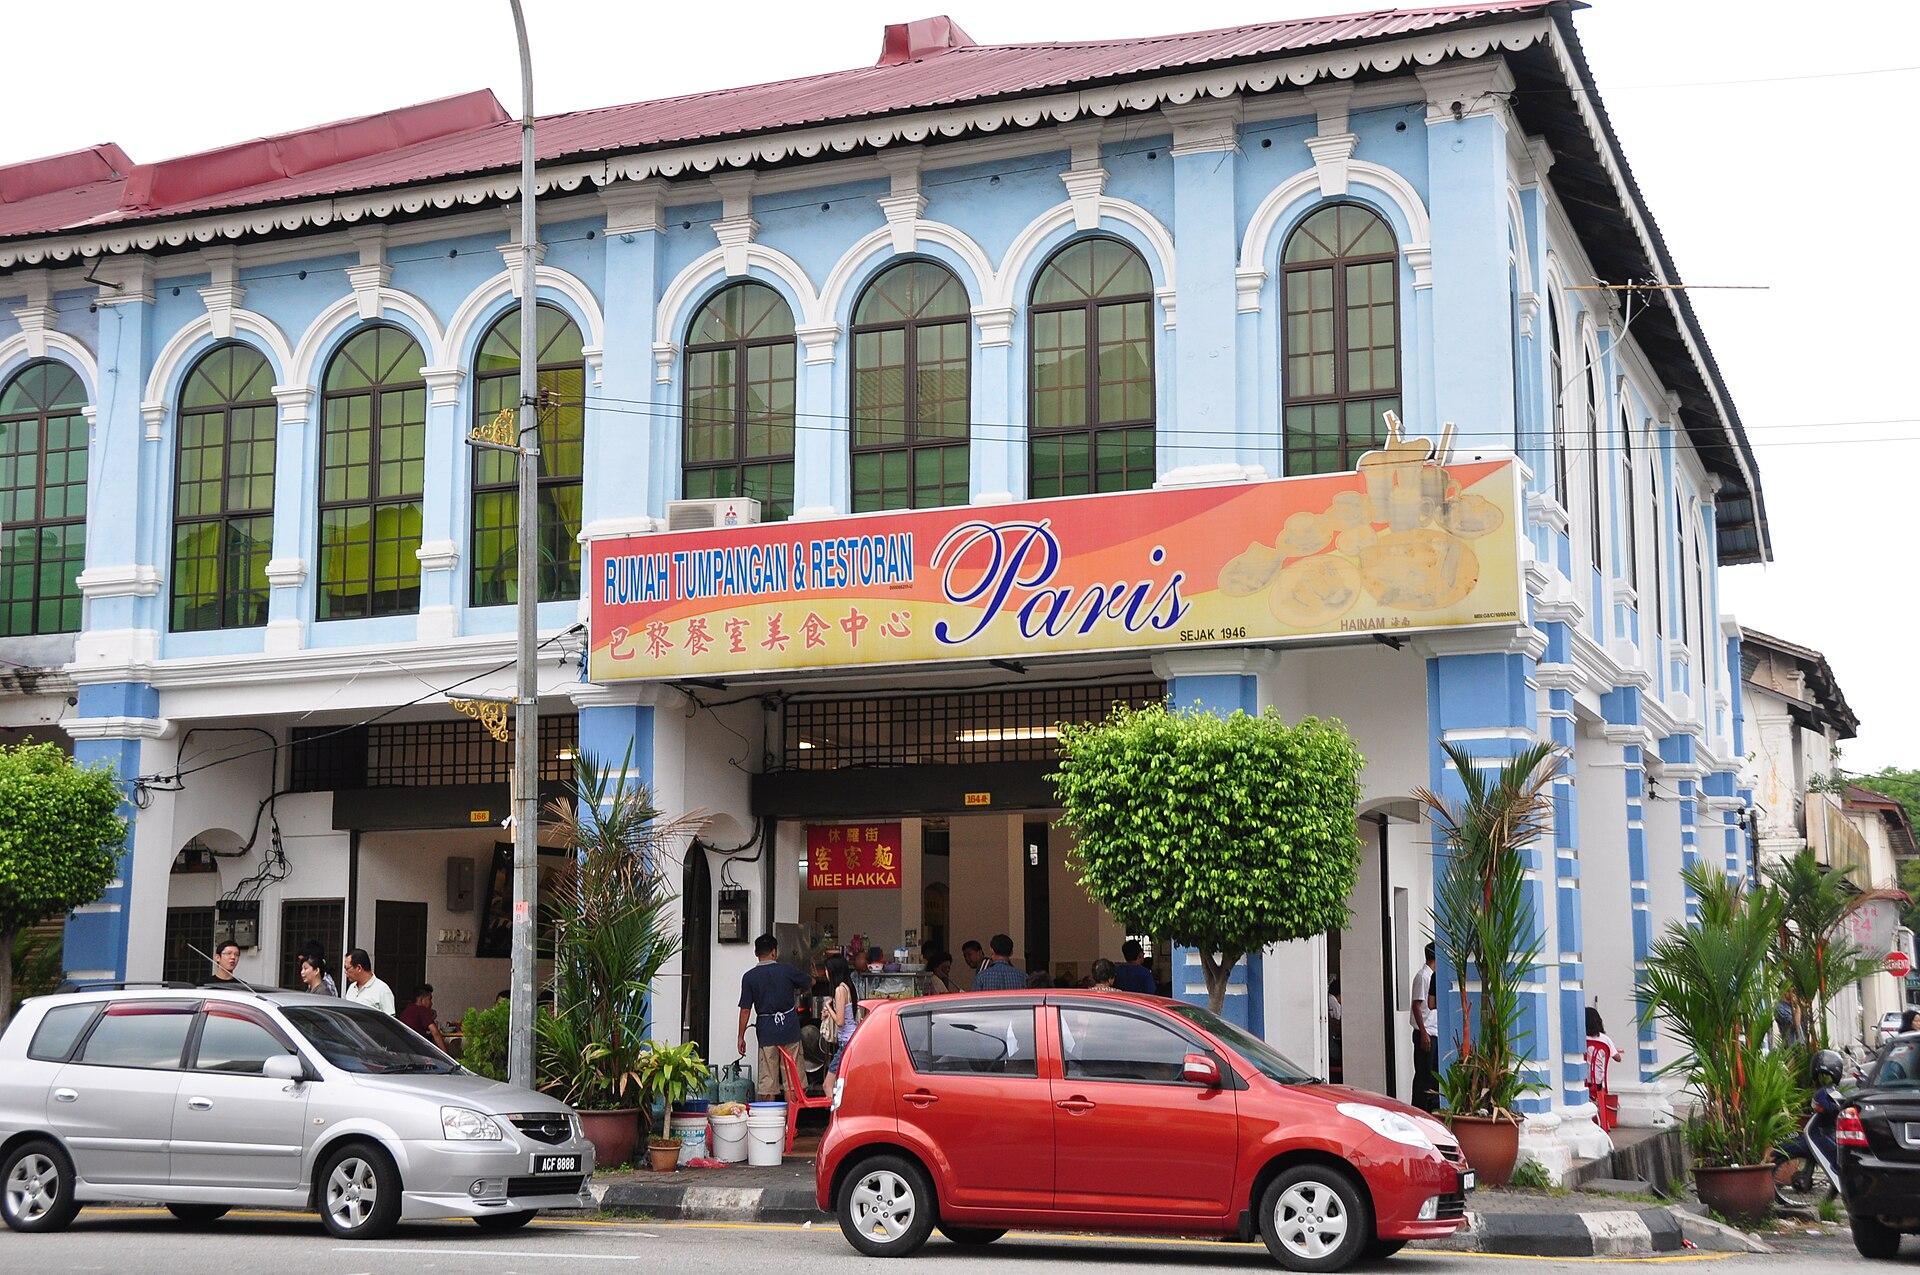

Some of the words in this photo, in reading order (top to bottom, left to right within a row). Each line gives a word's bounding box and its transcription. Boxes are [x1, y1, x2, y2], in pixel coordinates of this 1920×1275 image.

[605, 553, 669, 604] RUMAH
[674, 545, 787, 599] TUMPANGAN
[793, 543, 805, 591] &
[811, 533, 912, 589] RESTORAN
[932, 520, 1190, 644] Paris
[1340, 617, 1385, 631] HAINAM
[610, 607, 912, 661] 巴黎餐室美食中心
[1180, 628, 1215, 641] SEJAK
[1221, 626, 1246, 639] 1946
[813, 873, 842, 887] MEE
[846, 872, 897, 886] HAKKA
[542, 1157, 556, 1171] ACF
[556, 1157, 575, 1170] 8888
